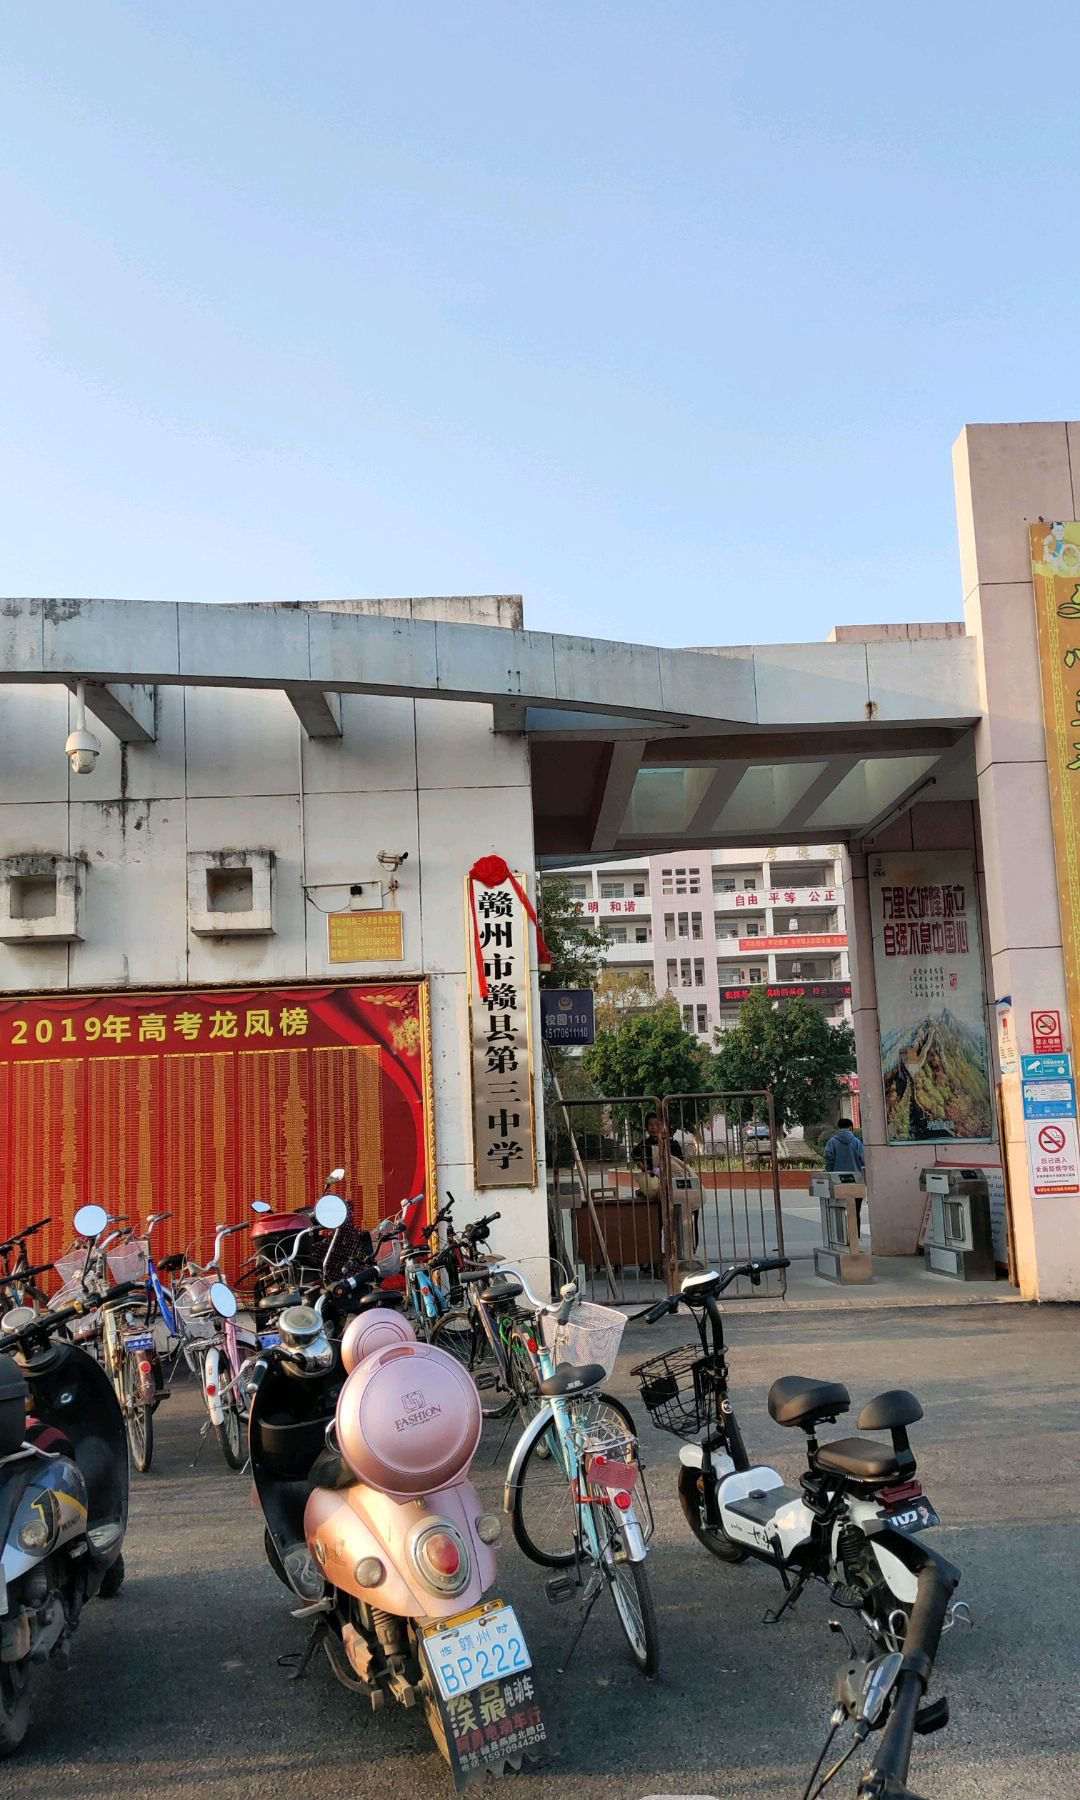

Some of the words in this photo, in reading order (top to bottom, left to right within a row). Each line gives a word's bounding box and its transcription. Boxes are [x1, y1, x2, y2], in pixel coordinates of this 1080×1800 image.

[609, 900, 635, 913] 和谐
[735, 893, 758, 907] 自由
[768, 891, 796, 904] 平等
[808, 889, 836, 902] 公正
[883, 920, 969, 956] 自强不息中国心
[11, 1007, 309, 1044] 2019年高考龙凤榜
[477, 890, 524, 1171] 赣州市赣县第三中学
[545, 1013, 587, 1026] 校园110
[394, 1404, 442, 1430] FASHION
[440, 1637, 525, 1694] BP222
[503, 1675, 534, 1707] 电动车
[451, 1700, 508, 1739] 沃狼
